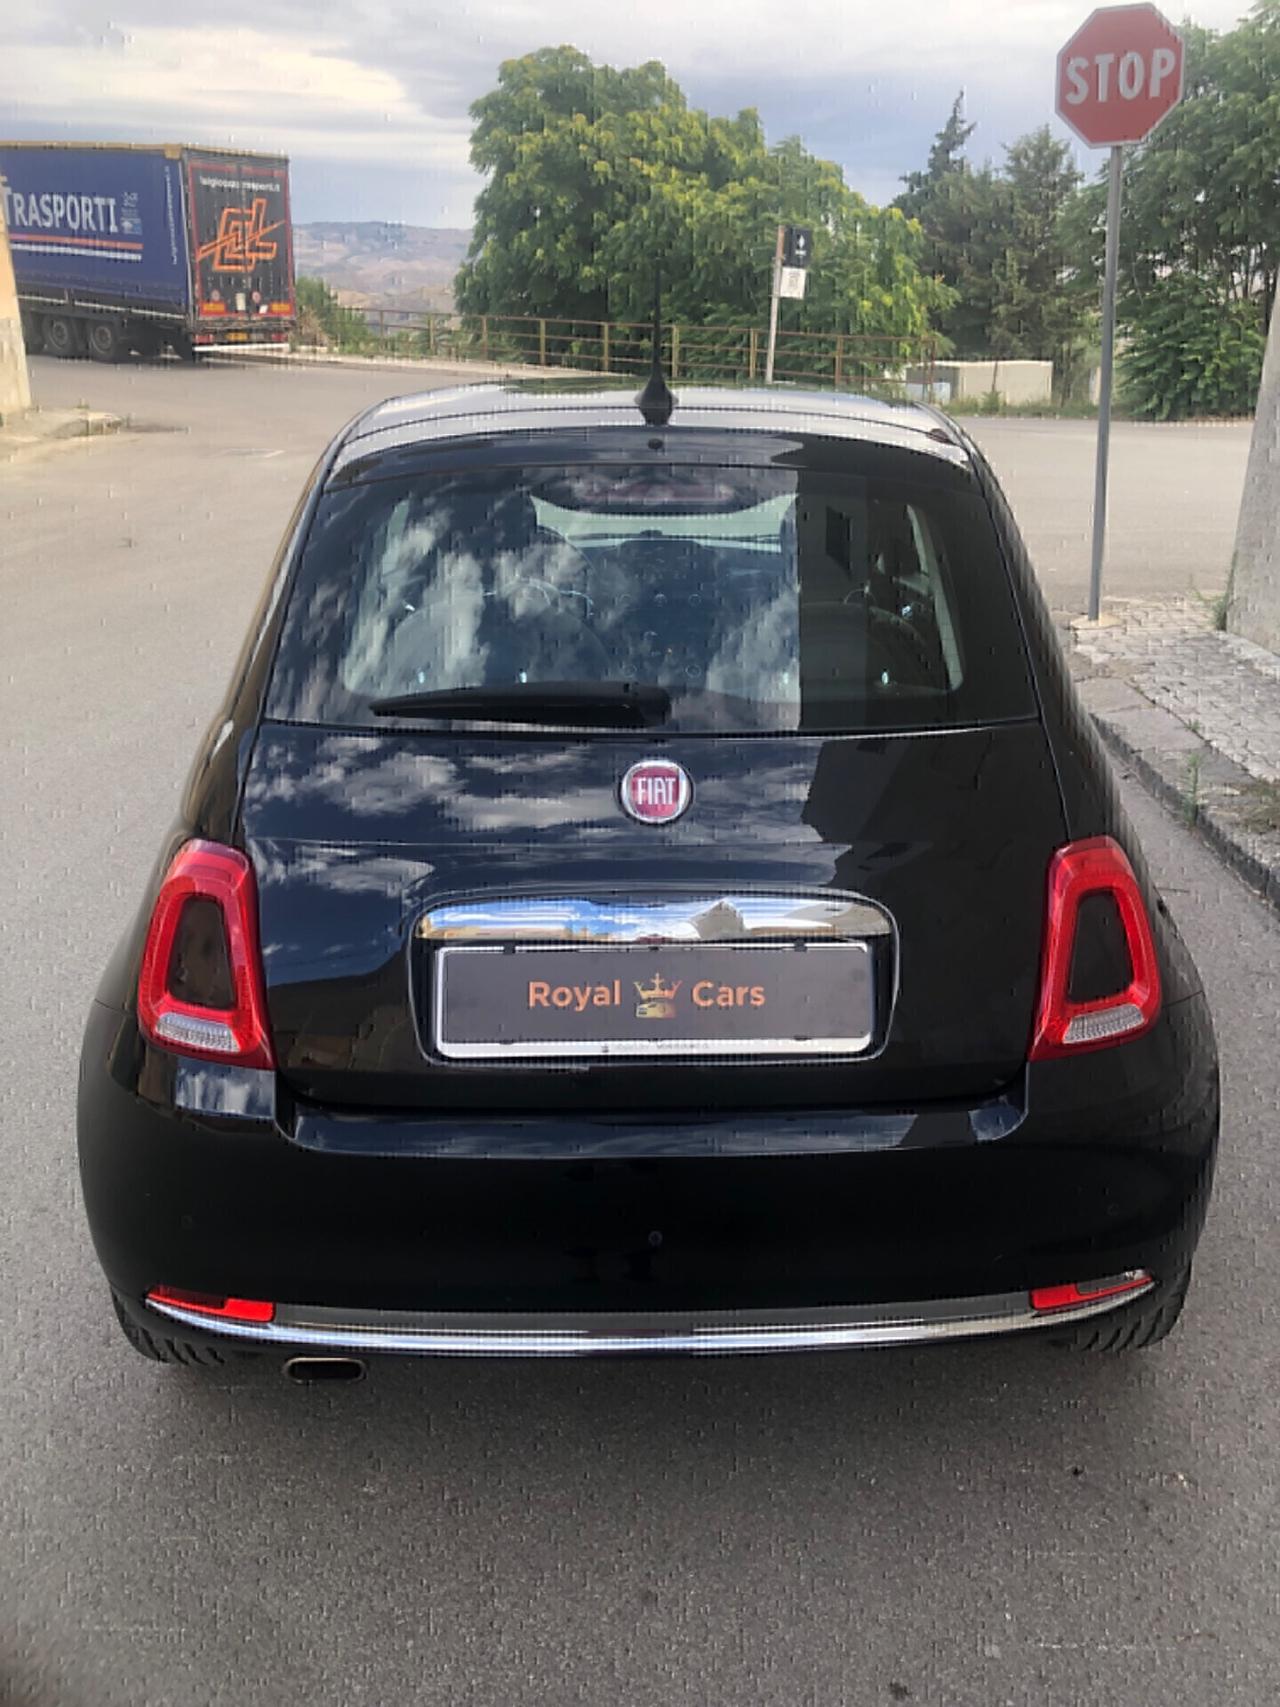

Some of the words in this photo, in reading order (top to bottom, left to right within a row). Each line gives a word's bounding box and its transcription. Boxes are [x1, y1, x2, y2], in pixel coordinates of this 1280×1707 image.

[1065, 48, 1176, 105] STOP
[637, 776, 676, 806] FIAT
[528, 979, 621, 1012] Royal
[692, 979, 766, 1007] Cars
